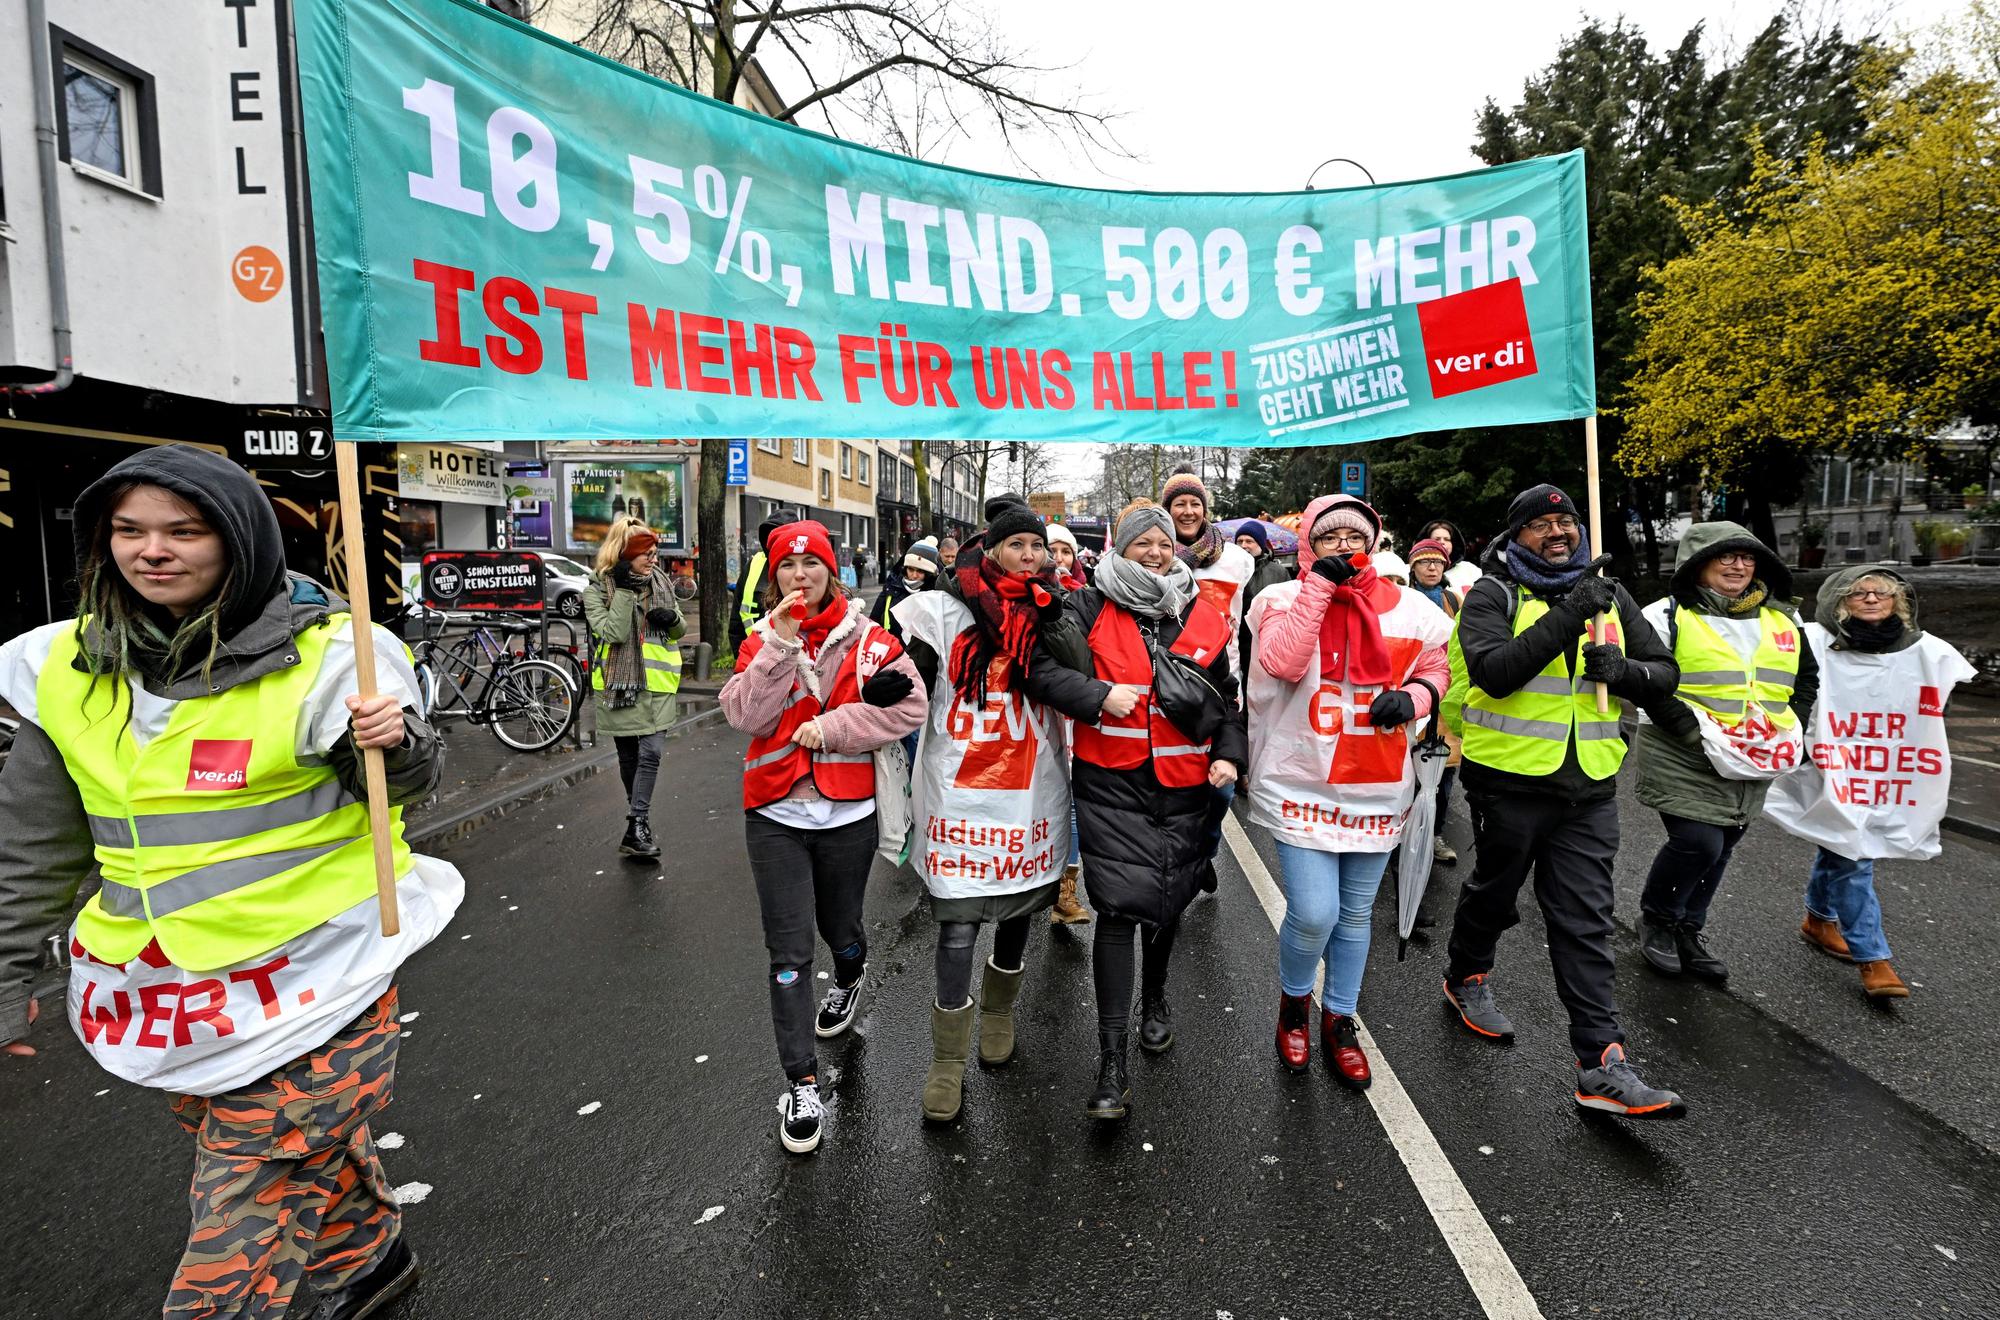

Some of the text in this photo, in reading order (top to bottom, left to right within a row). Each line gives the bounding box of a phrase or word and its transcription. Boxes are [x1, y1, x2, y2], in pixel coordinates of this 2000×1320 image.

[825, 184, 1081, 316] MIND.
[1102, 226, 1249, 320] 500
[1274, 224, 1324, 316] €
[1354, 215, 1539, 310] MEHR
[413, 258, 1240, 410] IST MEHR FÜR UNS ALLE!
[1251, 325, 1400, 390] ZUSAMMEN
[1434, 341, 1524, 375] ver.di
[1258, 365, 1407, 426] GEHT MEHR
[244, 430, 325, 456] CLUB Z
[429, 450, 499, 478] HOTEL
[584, 469, 625, 478] PATRICK'S
[729, 447, 745, 474] P
[437, 473, 497, 489] Willkommen
[583, 484, 605, 493] MÄRZ
[789, 540, 808, 548] GEW
[464, 574, 537, 590] REINSTELLEN!
[467, 564, 521, 577] SCHÖN EINEN
[946, 692, 1048, 741] GEW
[1309, 684, 1400, 735] GE
[1828, 711, 1906, 739] WIR
[1897, 746, 1943, 776] ES
[193, 769, 242, 784] ver.di
[1832, 778, 1916, 807] WERT.
[927, 815, 1048, 854] Bildung ist
[925, 846, 1054, 881] MehrWert!
[80, 955, 316, 1049] WERT.
